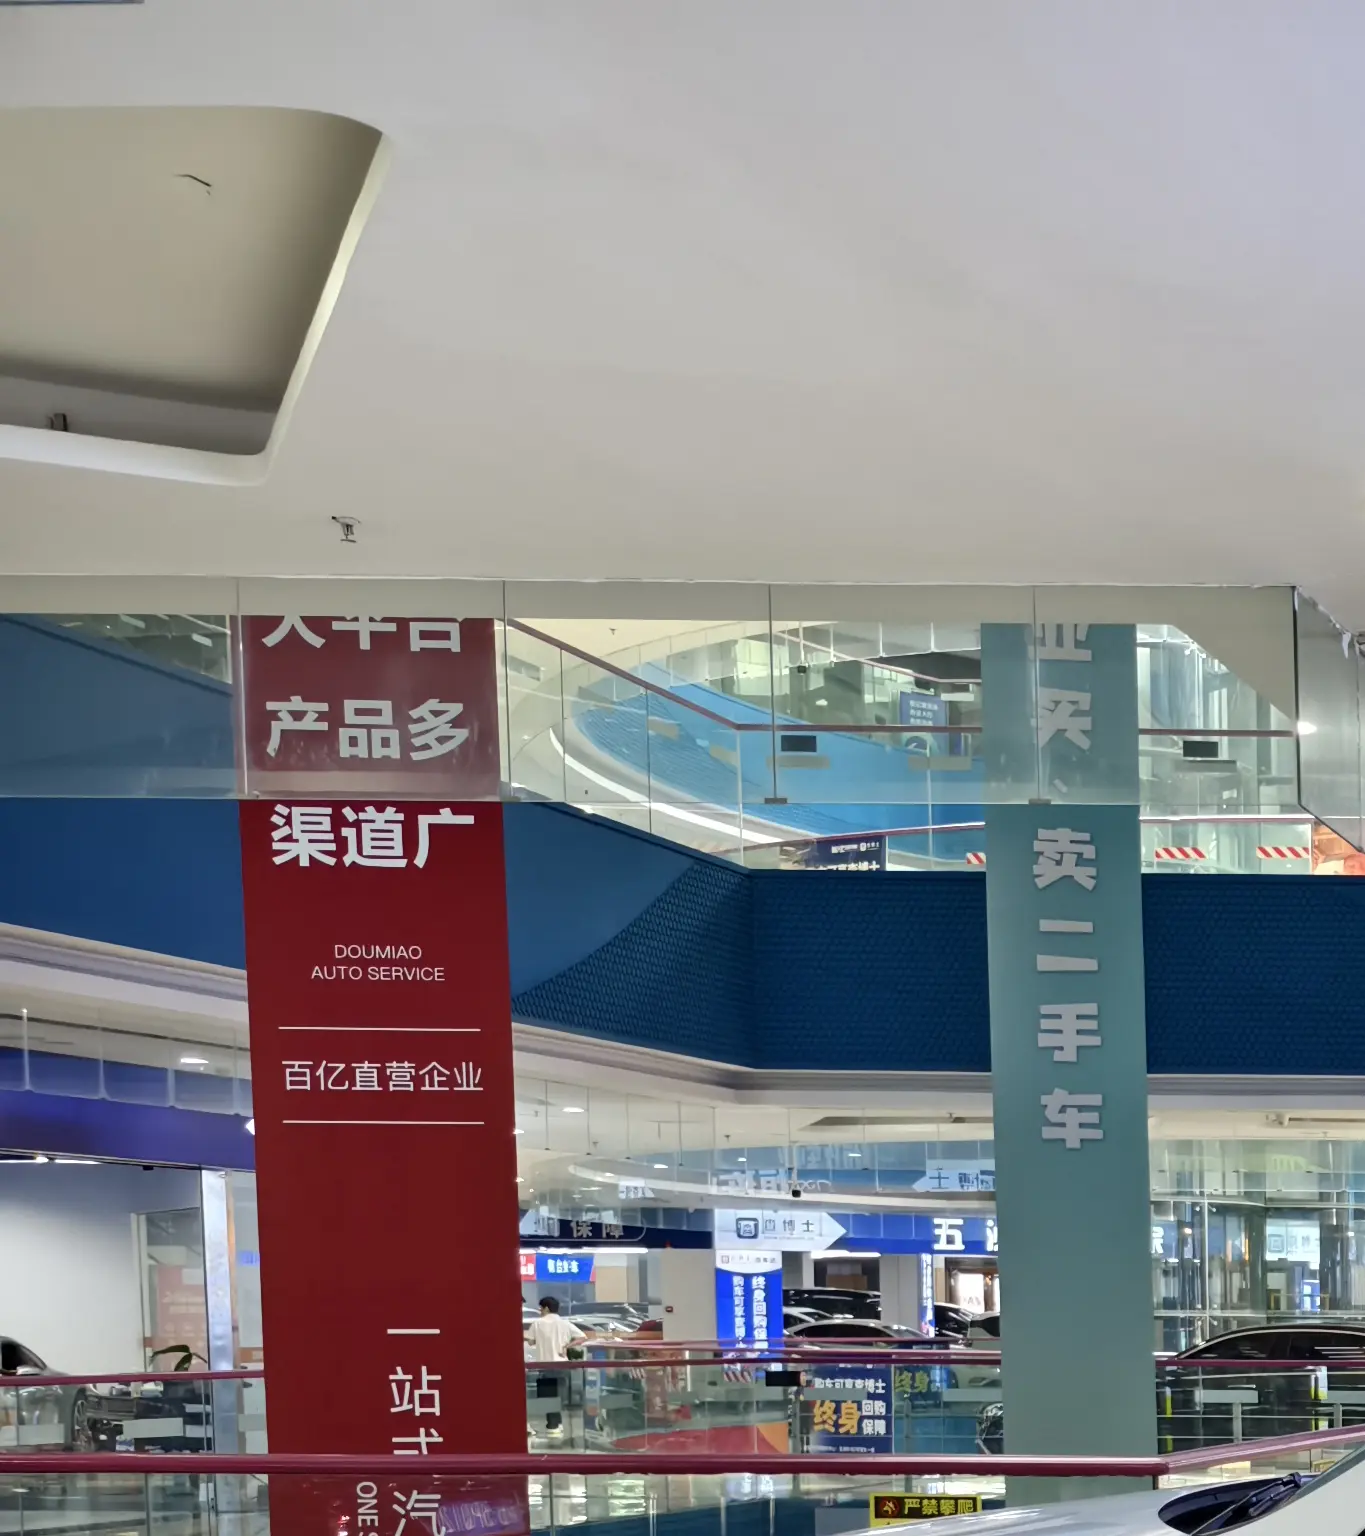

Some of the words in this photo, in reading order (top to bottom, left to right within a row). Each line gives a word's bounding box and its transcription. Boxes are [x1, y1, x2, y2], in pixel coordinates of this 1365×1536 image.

[265, 696, 469, 761] 产品多
[270, 803, 475, 868] 渠道广
[333, 944, 422, 960] DOUMIAO
[311, 965, 363, 980] AUTO
[367, 966, 446, 981] SERVICE
[282, 1060, 484, 1092] 百亿直营企业
[813, 1400, 861, 1435] 终身
[356, 1481, 379, 1527] ONE
[903, 1498, 975, 1516] 严禁攀爬
